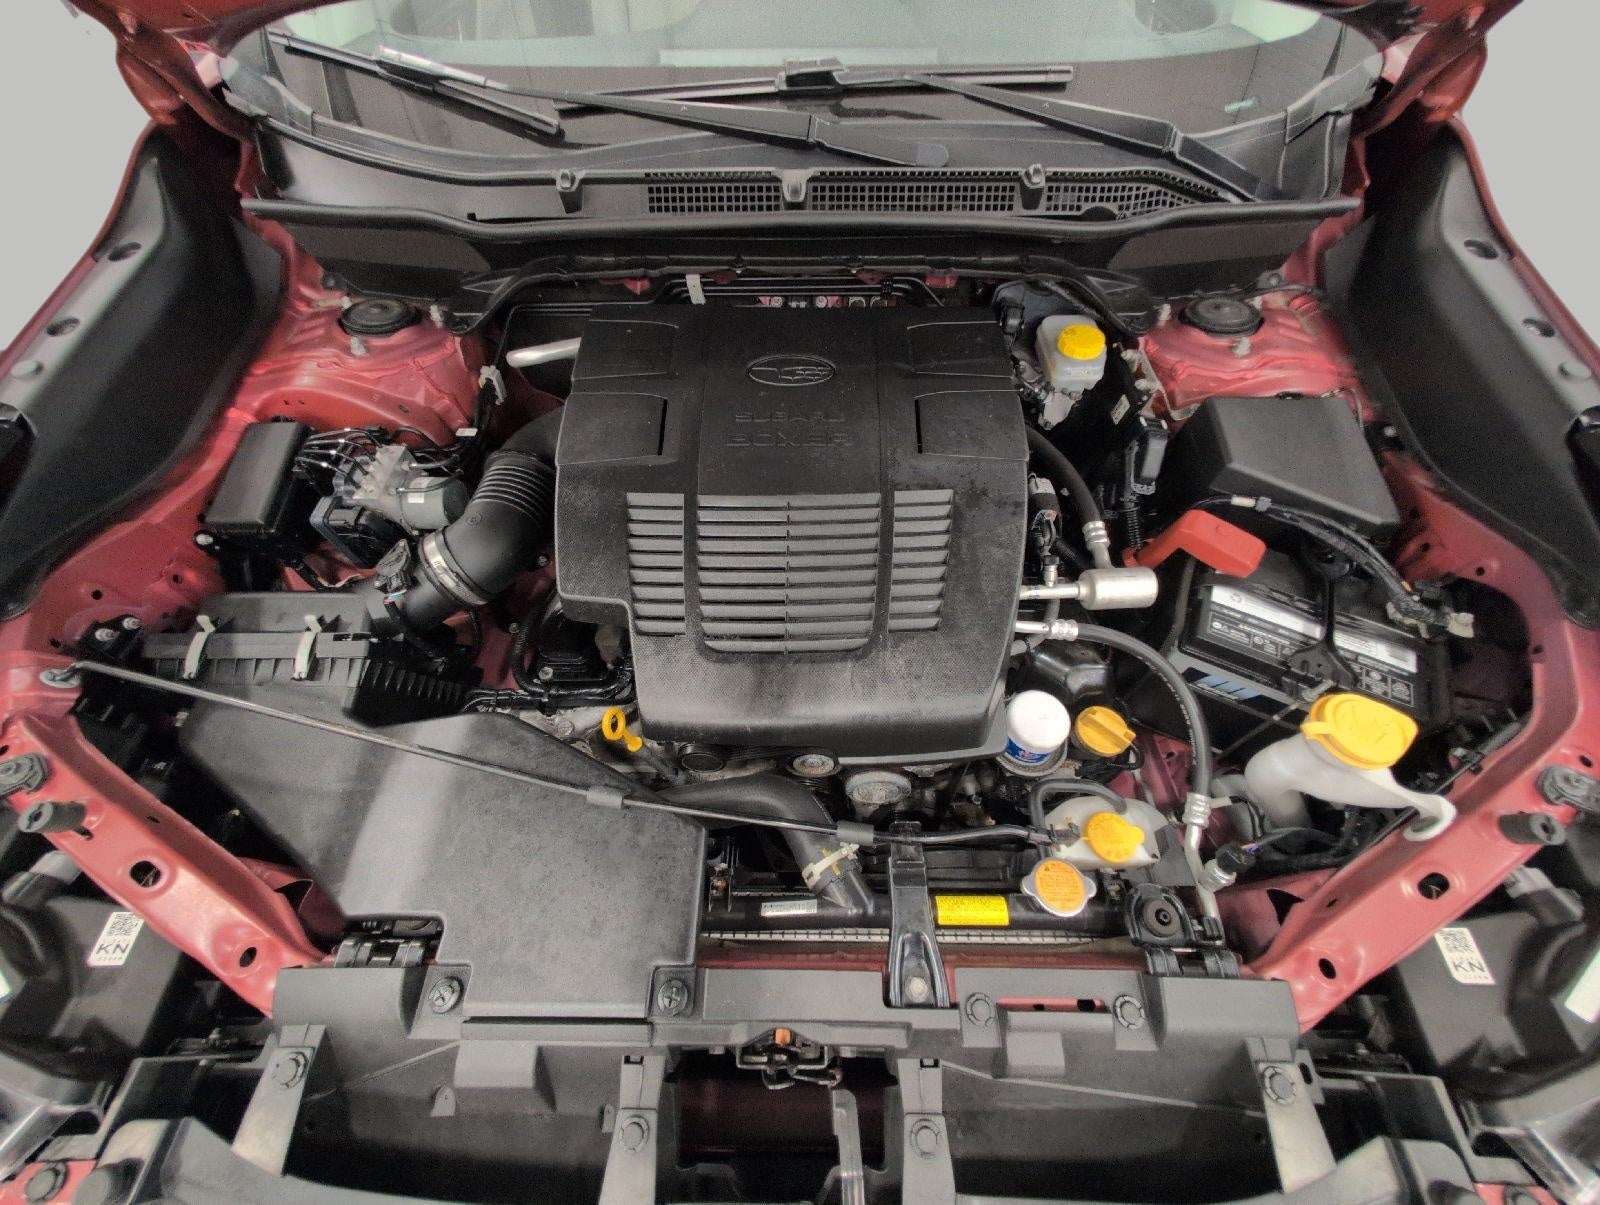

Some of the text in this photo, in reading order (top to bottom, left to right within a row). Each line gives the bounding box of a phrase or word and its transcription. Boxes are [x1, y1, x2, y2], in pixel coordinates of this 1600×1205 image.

[735, 411, 846, 423] SUBARU
[727, 432, 855, 447] BOXER
[96, 943, 130, 955] KN
[1452, 960, 1485, 973] KN
